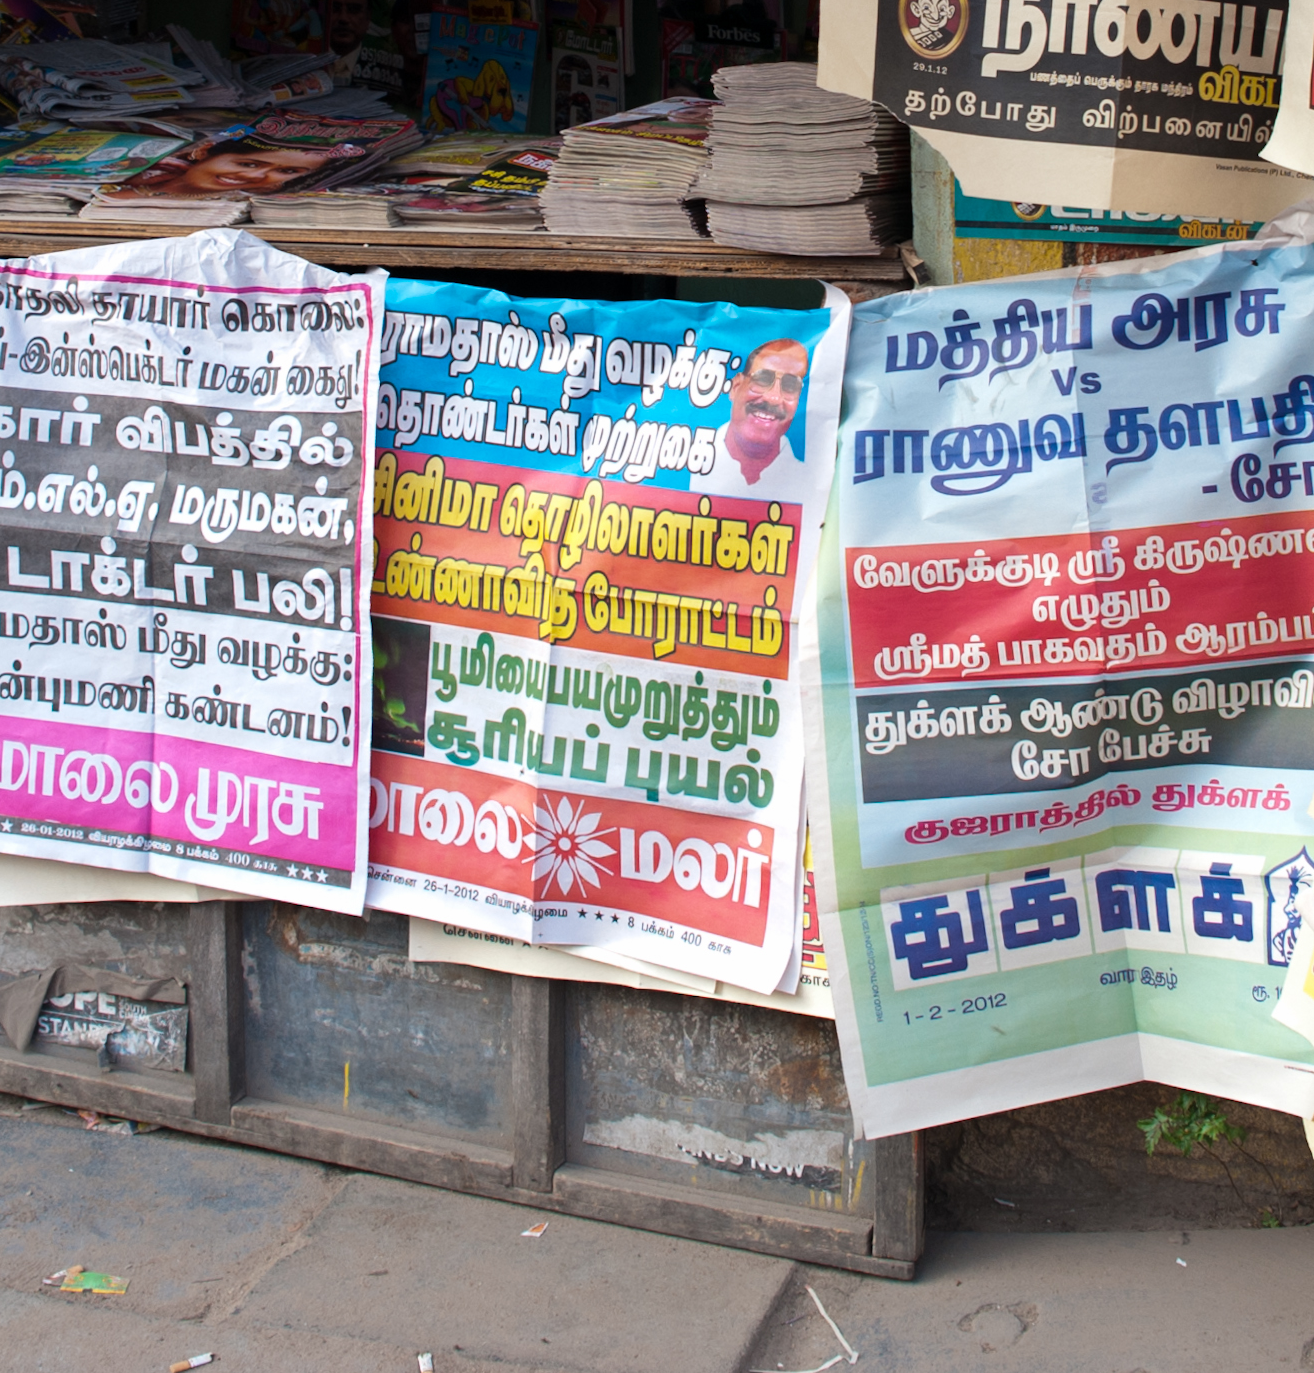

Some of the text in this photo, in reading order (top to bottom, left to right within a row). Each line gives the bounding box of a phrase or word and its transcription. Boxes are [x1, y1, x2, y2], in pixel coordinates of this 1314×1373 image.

[706, 24, 762, 45] Forbes
[912, 61, 949, 76] 29.1.12
[903, 87, 1060, 131] தற்போது
[91, 284, 212, 329] தாயார்
[885, 287, 1287, 392] மத்திய அரசு
[198, 349, 280, 398] மகன்
[539, 312, 604, 399] மீது
[115, 404, 354, 471] விபத்தில்
[376, 378, 582, 450] தொண்டர்கள்
[852, 411, 1088, 496] ராணுவ
[500, 478, 794, 578] தொழிலாளர்கள்
[6, 535, 216, 607] டாக்டர்
[583, 571, 786, 660] போராட்டம்
[1031, 579, 1171, 632] எழுதும்
[997, 623, 1168, 674] பாகவதம்
[864, 687, 1164, 754] துக்ளக் ஆண்டு
[1097, 724, 1213, 764] பேச்சு
[427, 707, 776, 809] சூரியப் புயல்
[183, 764, 326, 847] முரசு
[1150, 779, 1292, 812] துக்ளக்
[618, 827, 769, 908] மலர்
[423, 880, 703, 948] 26-1-2012 பக்கம் 400
[889, 861, 1255, 982] துக்ளக்
[1098, 965, 1179, 991] வார இதழ்
